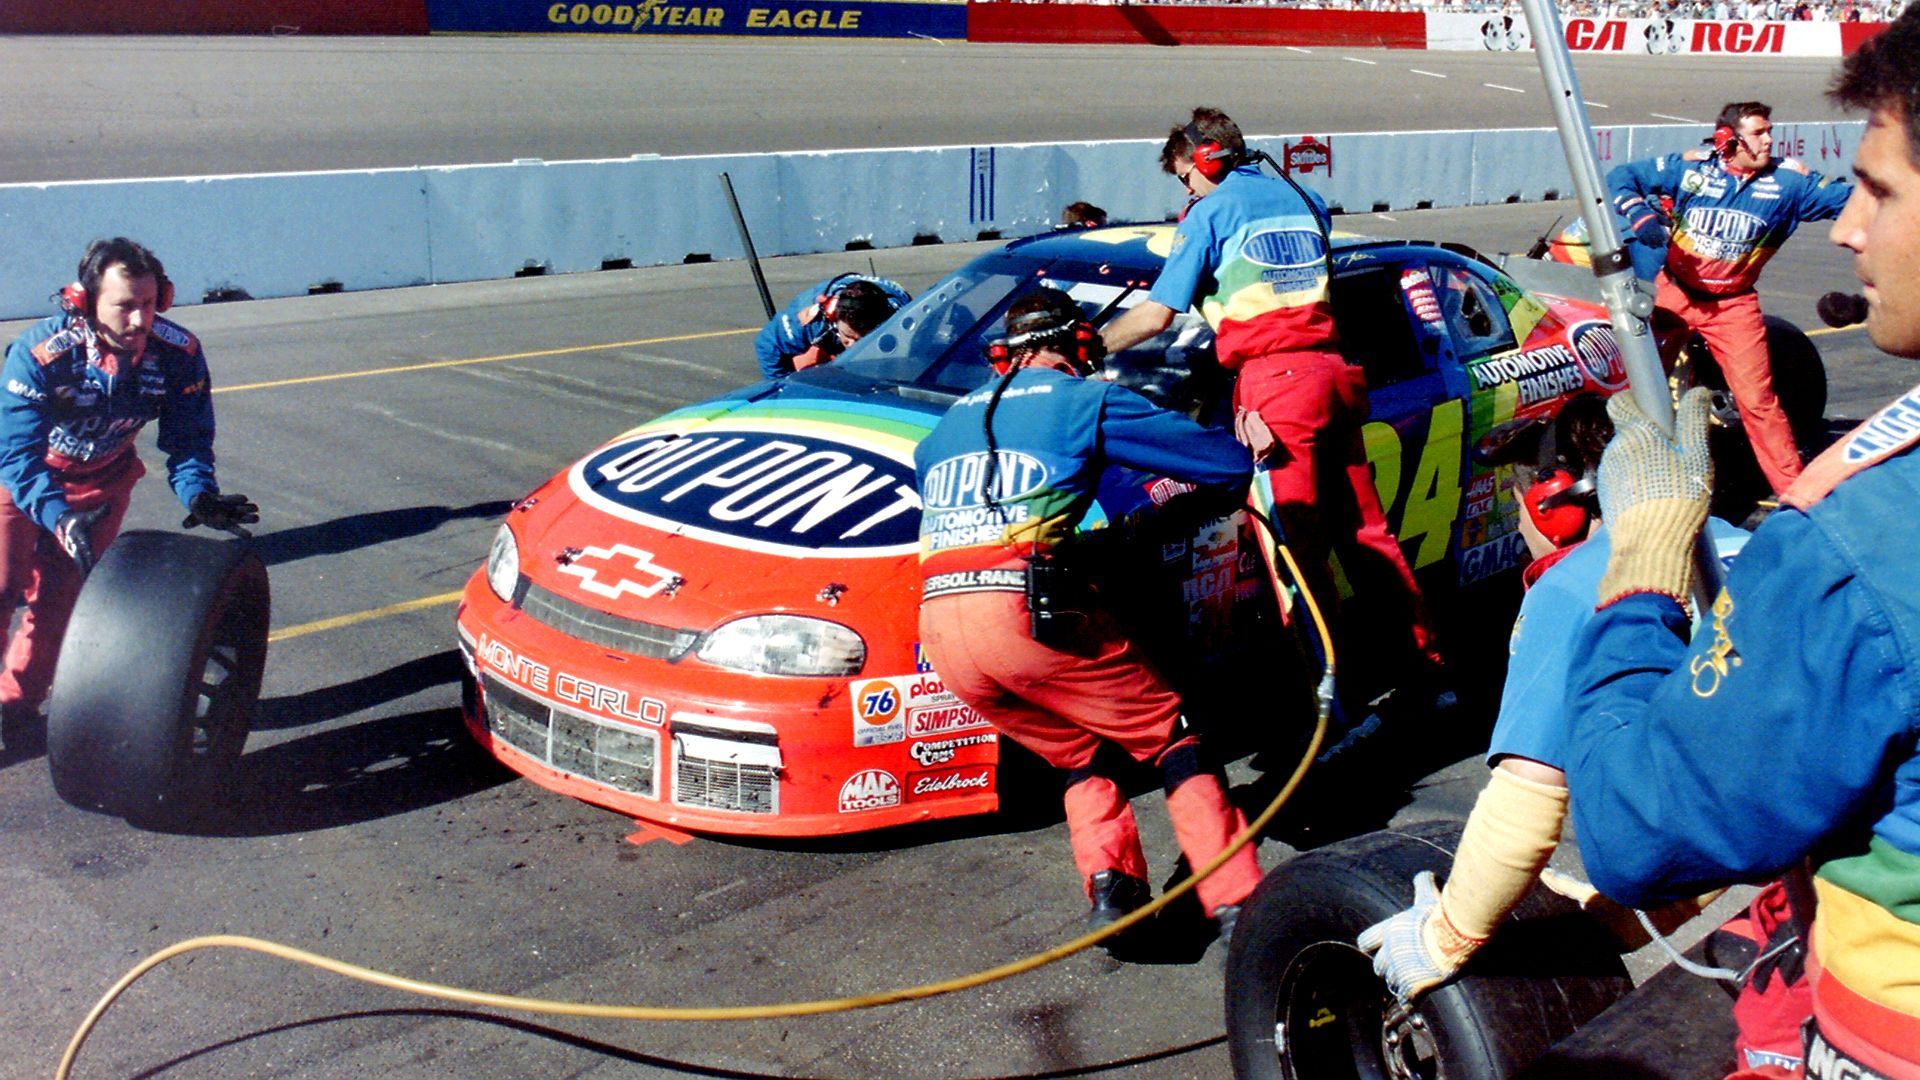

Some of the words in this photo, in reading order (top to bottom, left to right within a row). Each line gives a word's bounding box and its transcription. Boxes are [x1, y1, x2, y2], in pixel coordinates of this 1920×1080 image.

[747, 8, 861, 29] EAGLE
[1530, 20, 1627, 50] CA
[1690, 22, 1785, 53] RCA
[1471, 344, 1575, 389] AUTOMOTIVE
[1517, 365, 1584, 406] FINISHES
[924, 505, 1028, 534] AUTOMOTIVE
[929, 524, 1005, 550] FINISHES
[1184, 567, 1231, 602] RCA
[478, 633, 550, 692] MONTE
[555, 671, 668, 727] CARLO
[910, 677, 946, 699] plas
[863, 688, 896, 718] 76
[910, 733, 997, 759] COMPETITION
[843, 772, 898, 801] MAC
[913, 772, 989, 795] Edelbrock
[841, 794, 899, 810] TOOLS
